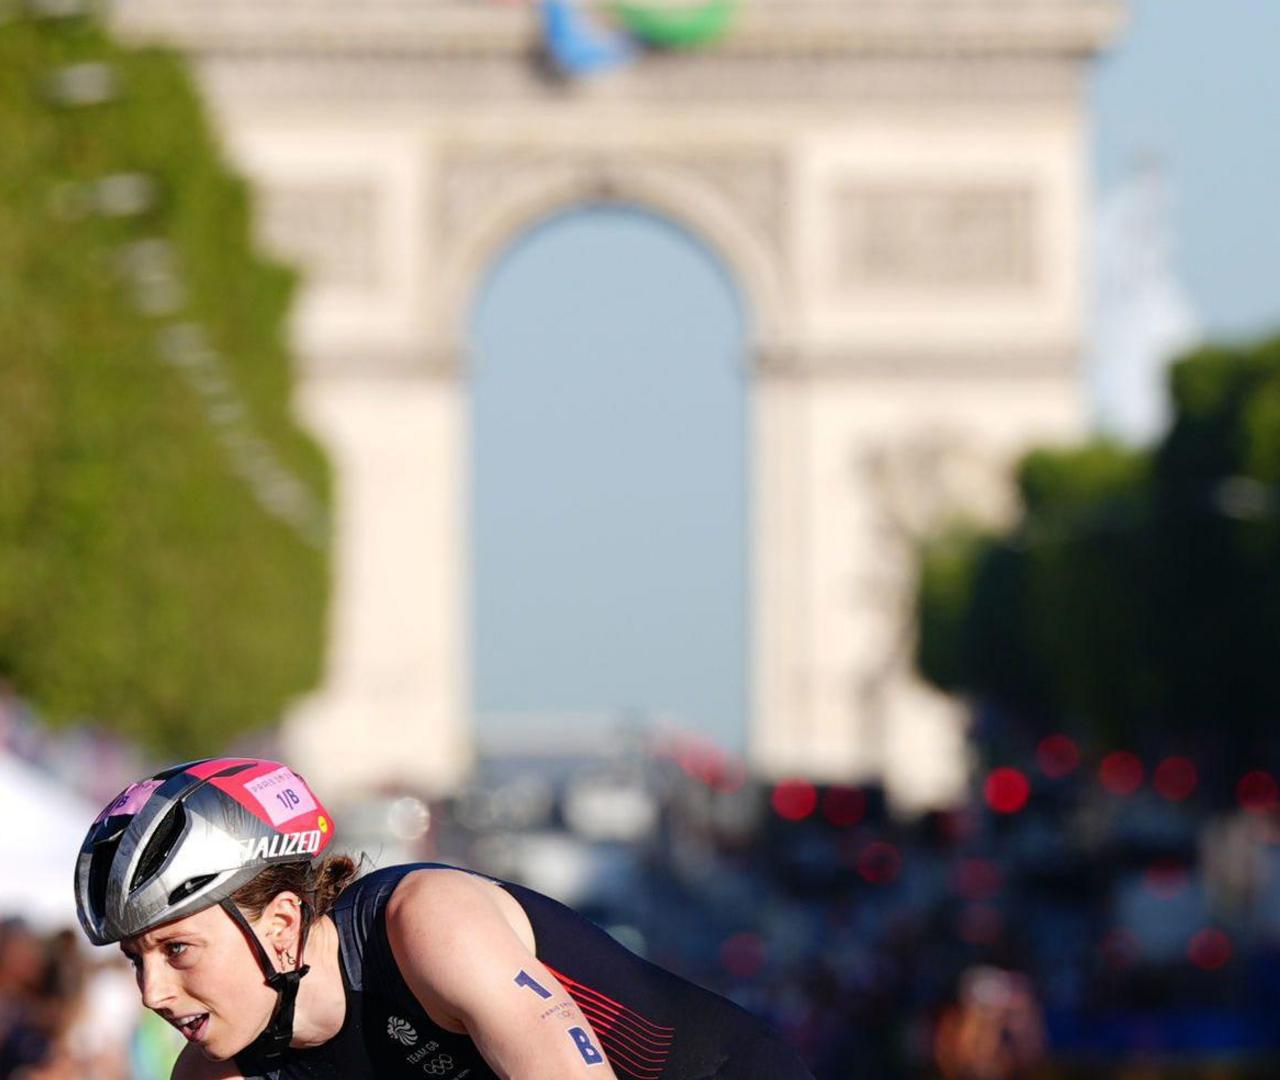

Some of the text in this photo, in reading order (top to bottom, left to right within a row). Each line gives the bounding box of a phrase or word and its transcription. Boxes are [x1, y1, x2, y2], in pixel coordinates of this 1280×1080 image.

[276, 788, 300, 810] 1/B
[513, 969, 553, 999] 1
[406, 1047, 429, 1064] TEAM
[567, 1026, 603, 1065] B
